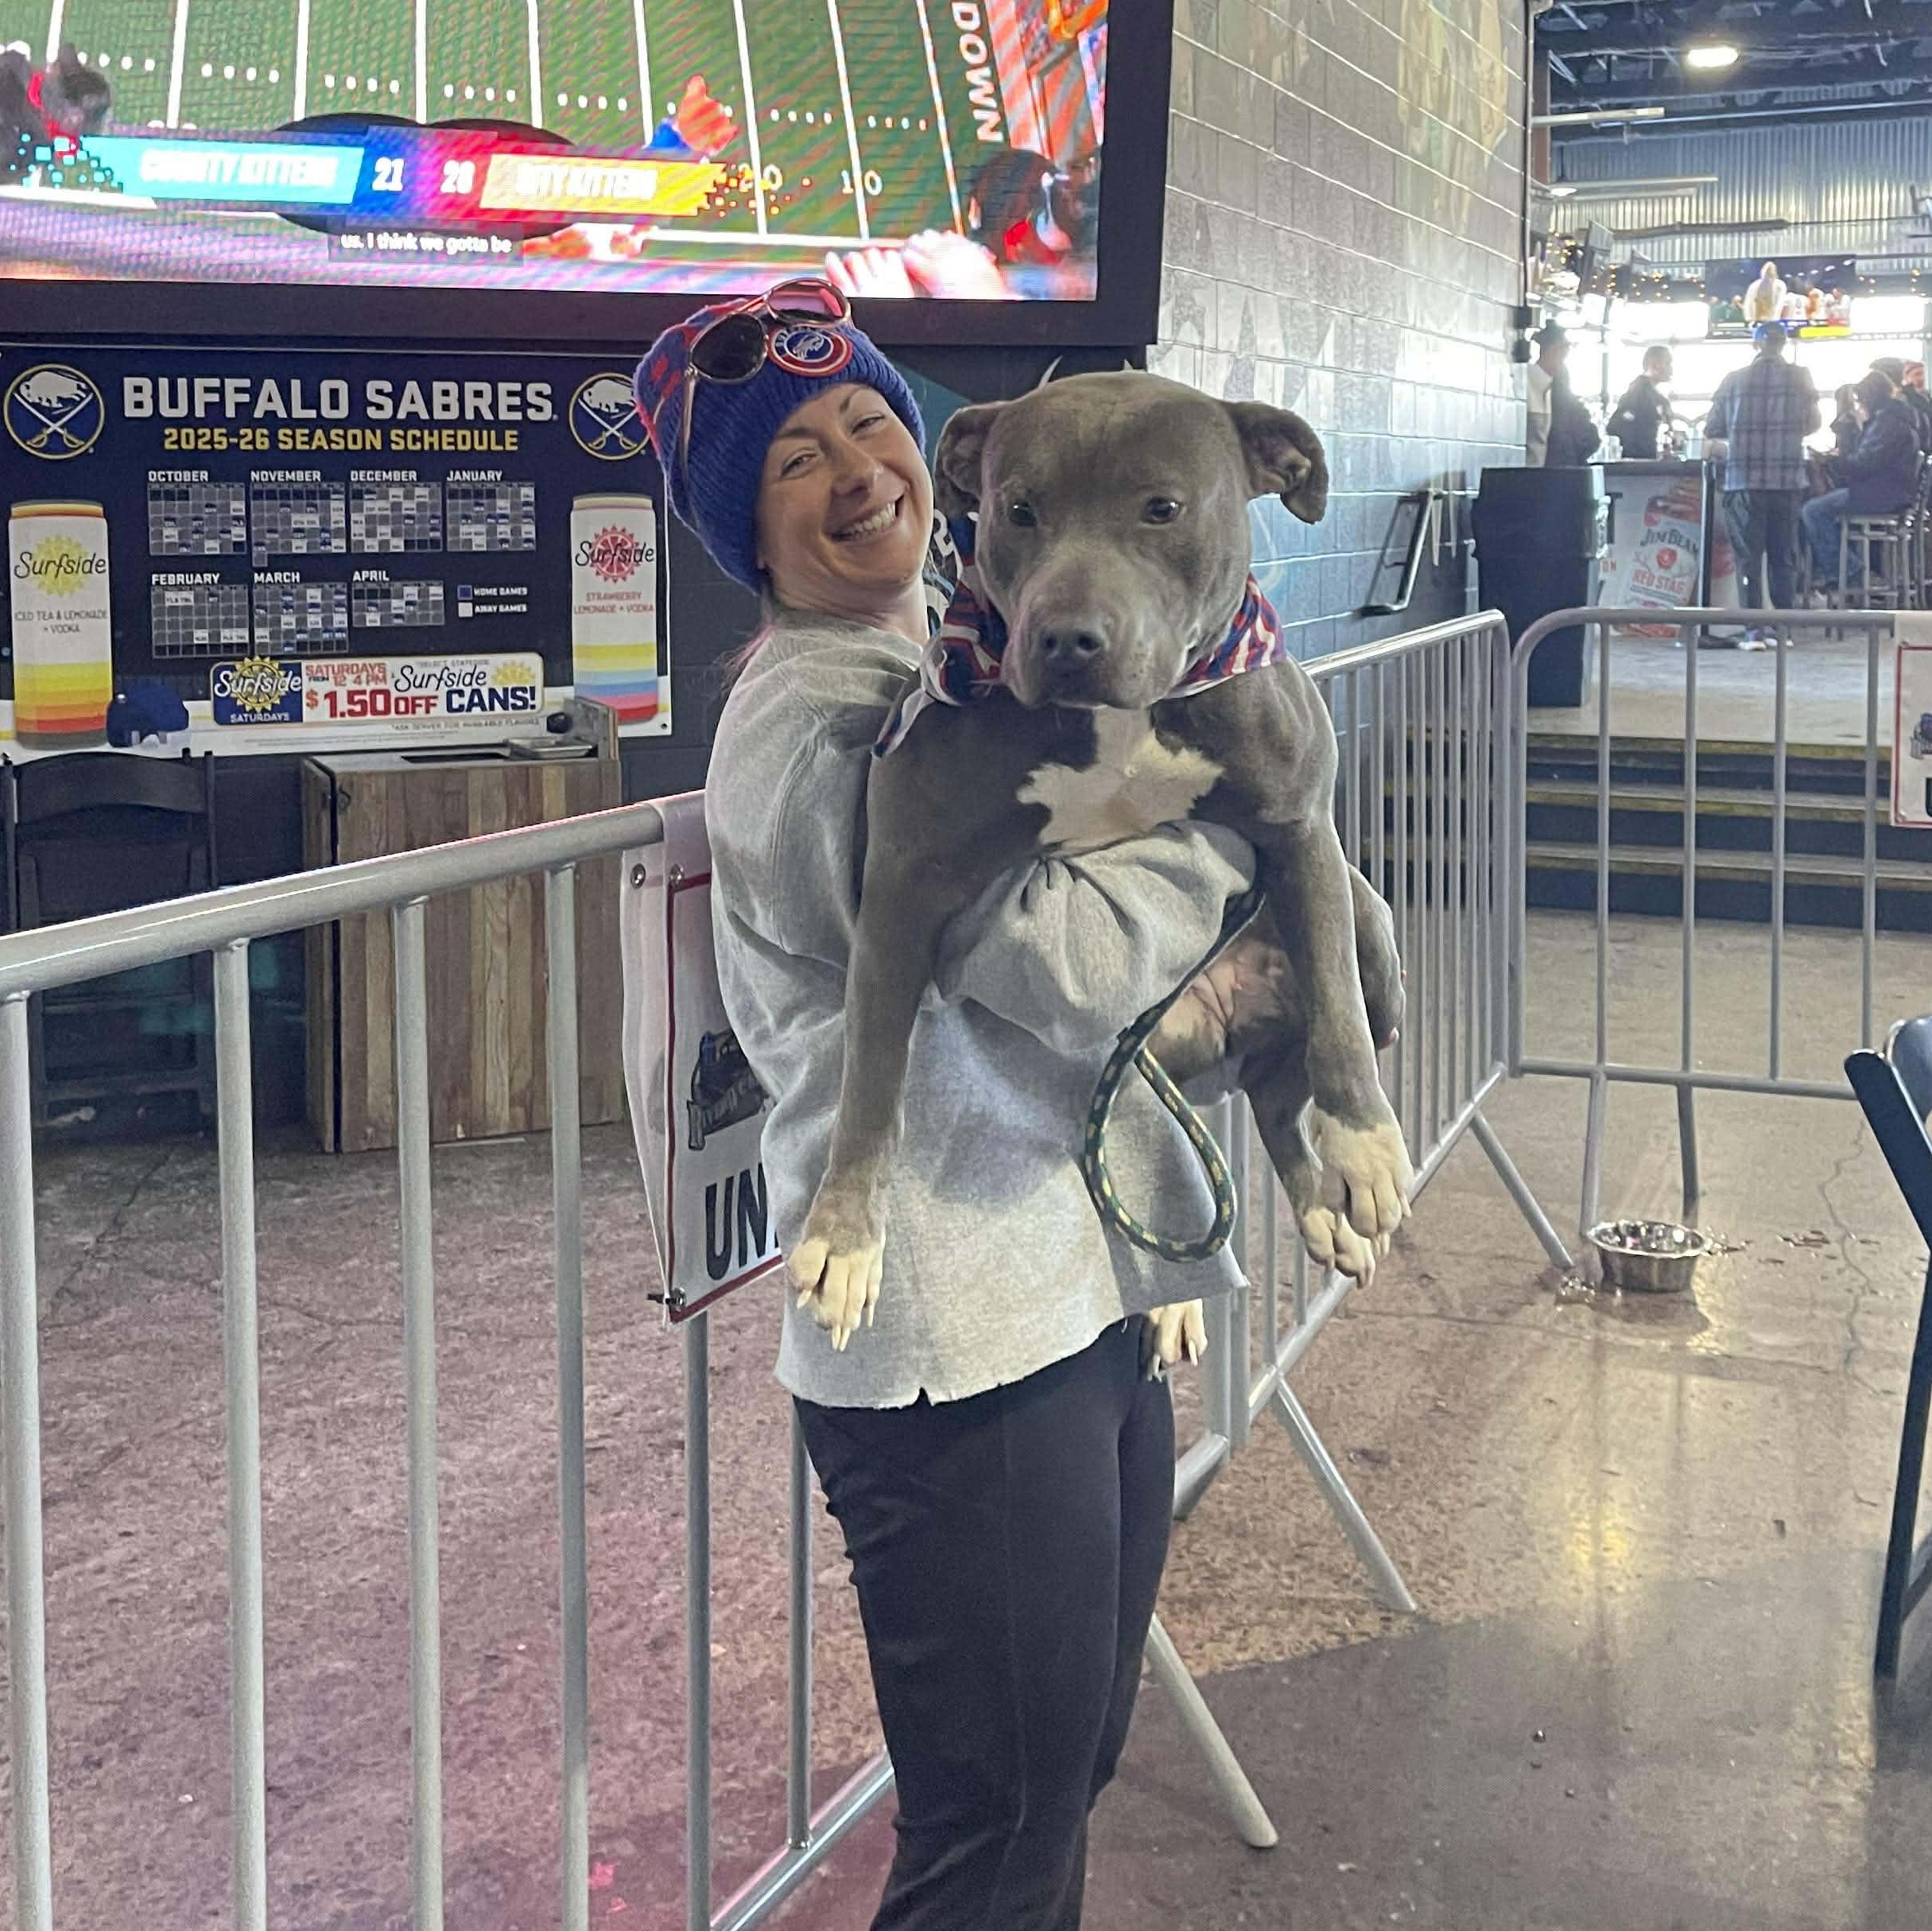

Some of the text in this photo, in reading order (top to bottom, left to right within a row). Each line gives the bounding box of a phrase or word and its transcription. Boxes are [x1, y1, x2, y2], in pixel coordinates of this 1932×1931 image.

[951, 2, 1003, 143] DOWN
[371, 157, 404, 191] 21
[377, 232, 418, 250] think
[420, 236, 444, 251] we
[491, 235, 512, 253] be
[122, 377, 553, 421] BUFFALO SABRES
[164, 427, 518, 452] 2025-26 SEASON SCHEDULE
[148, 470, 208, 483] OCTOBER
[250, 470, 321, 483] NOVEMBER
[350, 470, 417, 483] DECEMBER
[446, 470, 502, 483] JANUARY
[575, 541, 655, 567] Surfside
[14, 551, 107, 579] Surfside
[151, 572, 220, 585] FEBRUARY
[254, 572, 301, 584] MARCH
[352, 570, 390, 581] APRIL
[474, 587, 498, 596] HOME
[475, 604, 498, 613] AWAY
[305, 663, 386, 676] SATURDAYS
[214, 670, 302, 697] Surfside
[394, 665, 487, 692] Surfside
[394, 695, 439, 715] OFF
[446, 685, 536, 714] CANS!
[231, 712, 289, 723] SATURDAYS
[705, 1161, 779, 1281] UN
